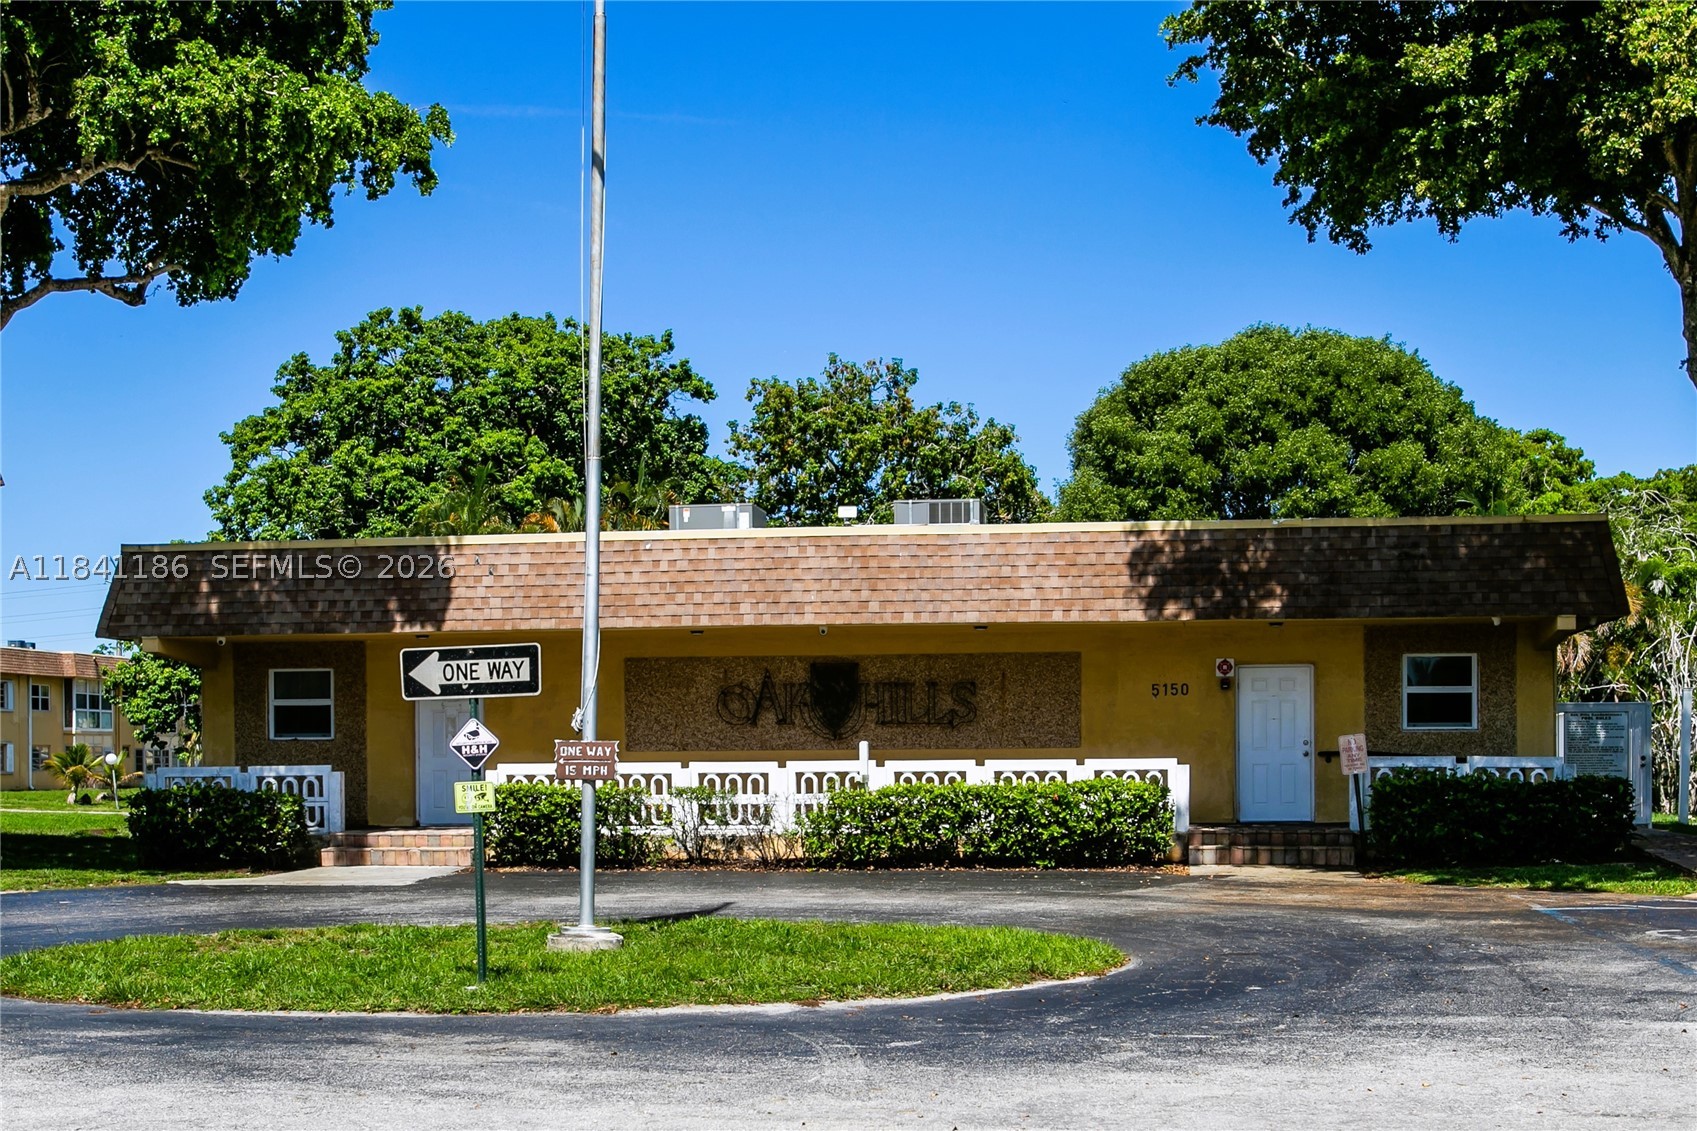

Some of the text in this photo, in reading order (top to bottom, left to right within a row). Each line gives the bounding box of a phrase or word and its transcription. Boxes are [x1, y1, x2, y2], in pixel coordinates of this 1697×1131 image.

[443, 660, 524, 681] ONE WAY
[1151, 683, 1189, 697] 5150
[717, 667, 811, 726] OAK
[461, 745, 488, 754] H&H
[560, 746, 611, 756] ONE WAY
[565, 765, 608, 775] 15 MPH
